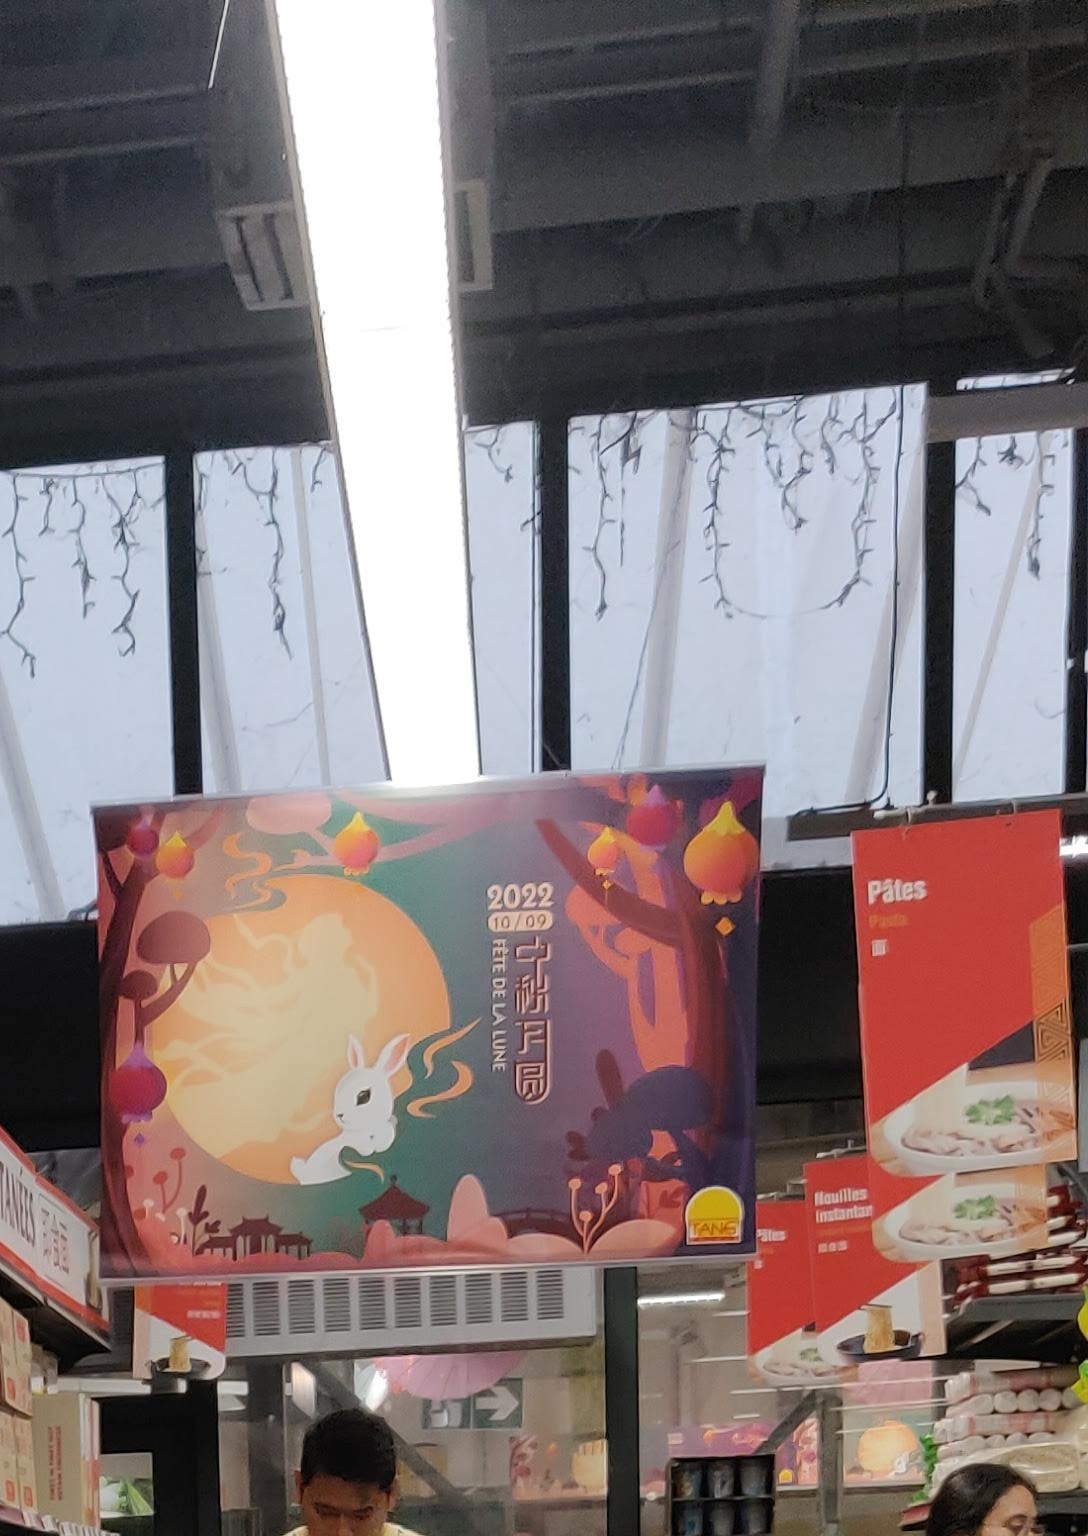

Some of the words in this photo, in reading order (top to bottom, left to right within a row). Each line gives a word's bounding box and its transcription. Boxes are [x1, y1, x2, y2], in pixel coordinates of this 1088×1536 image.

[487, 882, 554, 911] 2022
[868, 878, 928, 905] Pâtes
[492, 938, 509, 977] FÊTE
[492, 978, 507, 998] DE
[492, 1002, 507, 1026] LA
[492, 1030, 507, 1073] LUNE
[814, 1187, 868, 1206] Nouilles
